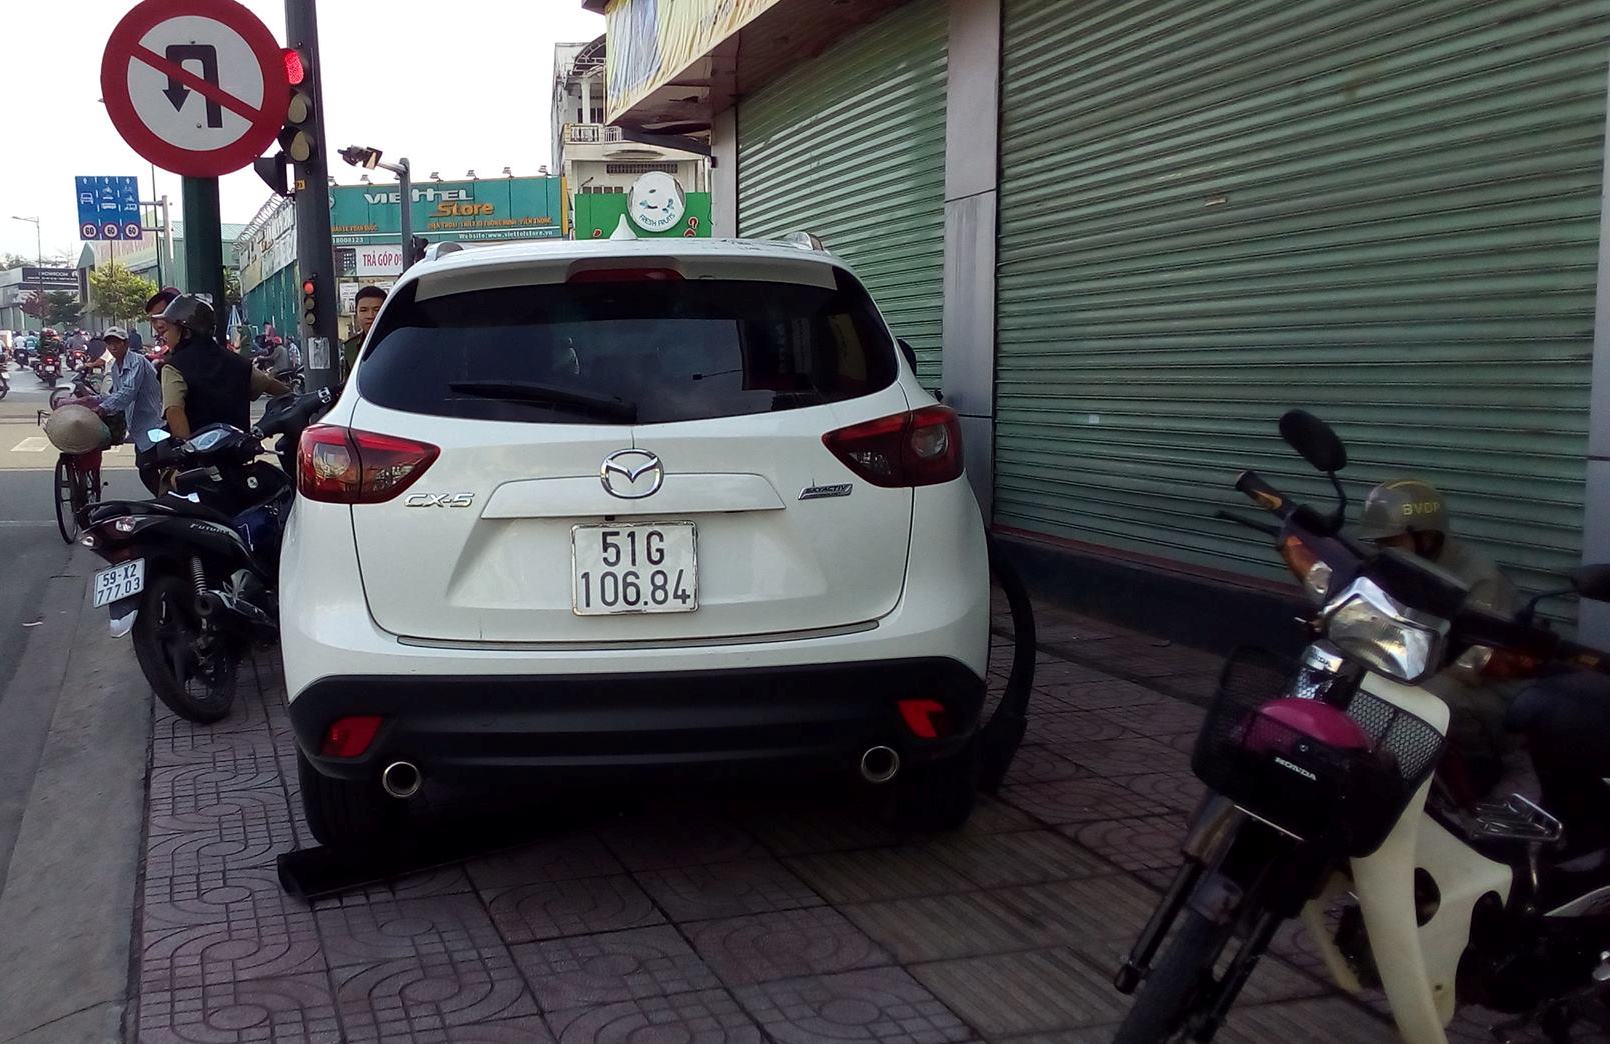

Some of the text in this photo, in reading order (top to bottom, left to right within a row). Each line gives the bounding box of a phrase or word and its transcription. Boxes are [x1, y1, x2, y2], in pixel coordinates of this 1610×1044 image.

[430, 201, 494, 217] Store
[363, 250, 377, 267] TRẢ
[377, 251, 393, 266] GÓP
[404, 493, 475, 508] CX-5
[601, 530, 665, 568] 51G
[102, 563, 137, 587] 59-X2
[97, 576, 140, 605] 777.03
[580, 568, 691, 608] 106.84
[1275, 756, 1317, 781] HONDA
